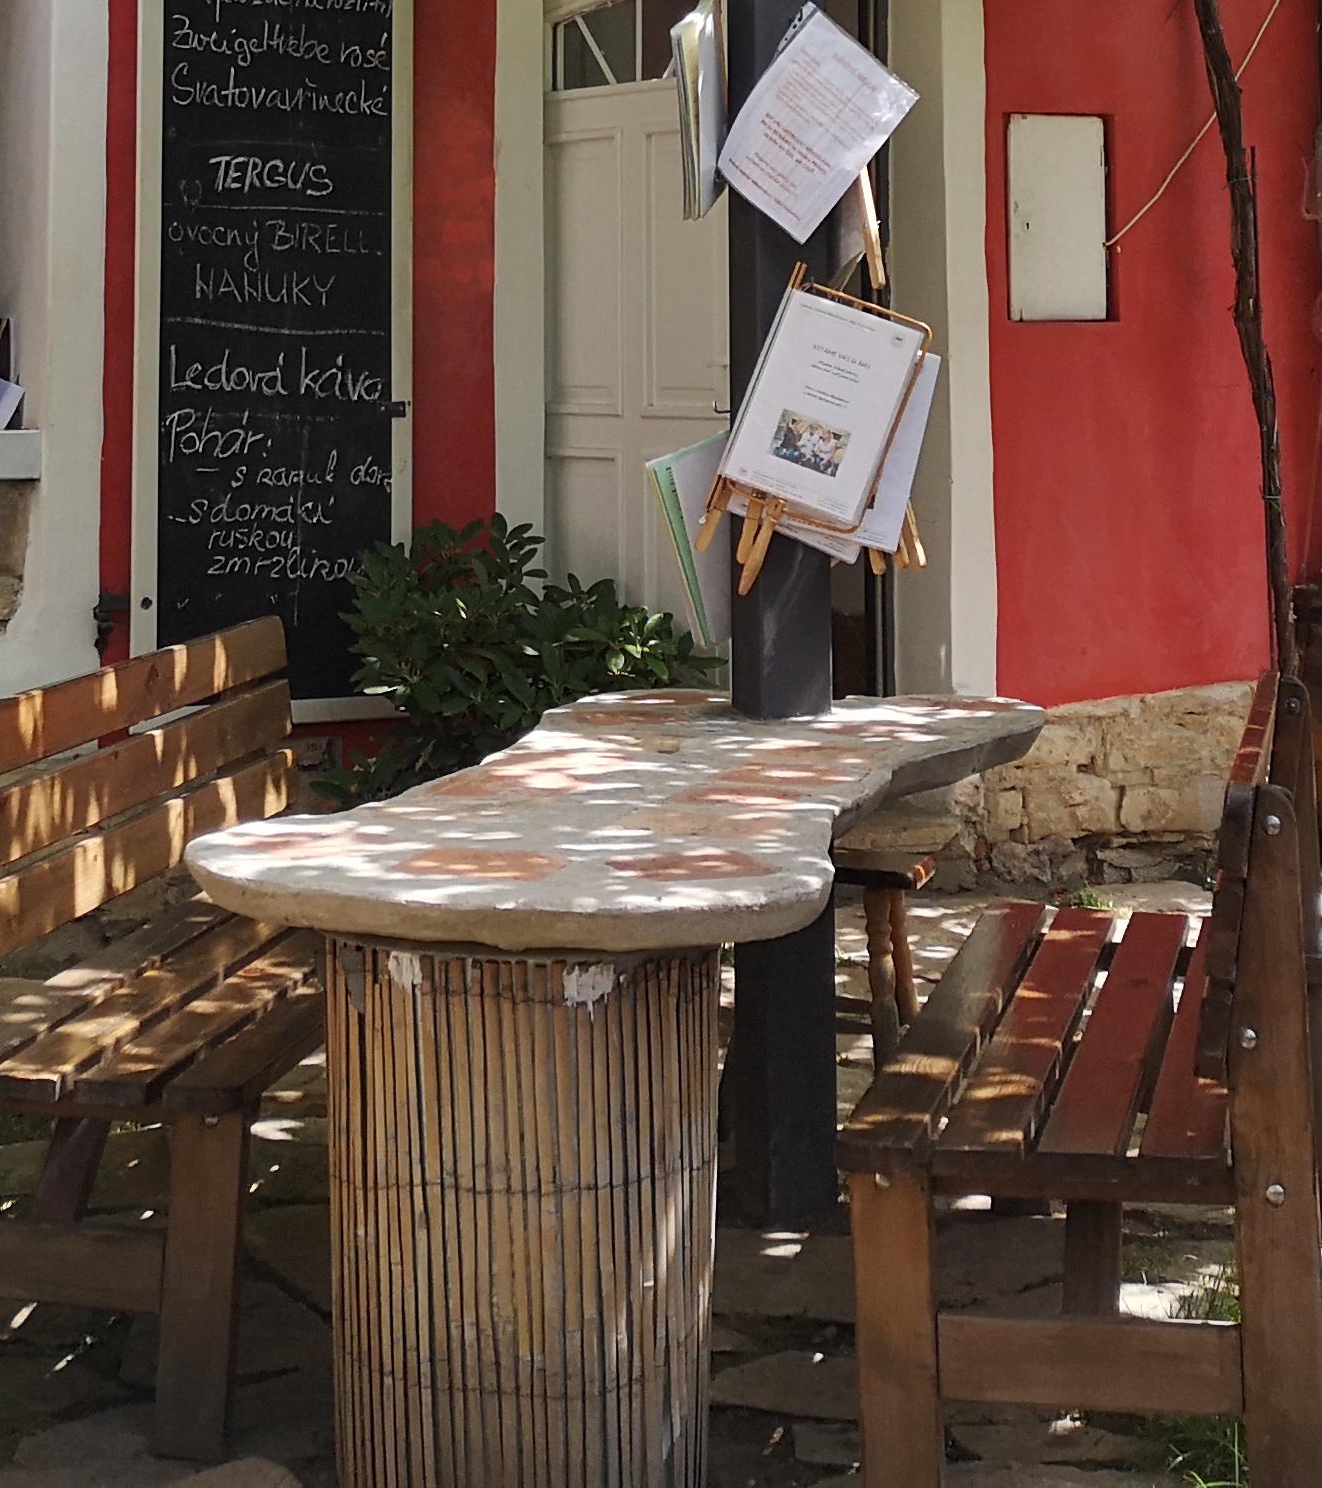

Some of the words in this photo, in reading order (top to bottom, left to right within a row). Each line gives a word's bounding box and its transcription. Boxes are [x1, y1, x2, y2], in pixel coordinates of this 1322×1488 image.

[340, 32, 390, 71] rosé
[208, 155, 333, 196] TERGUS
[170, 344, 288, 396] Ledová
[300, 345, 382, 401] káva
